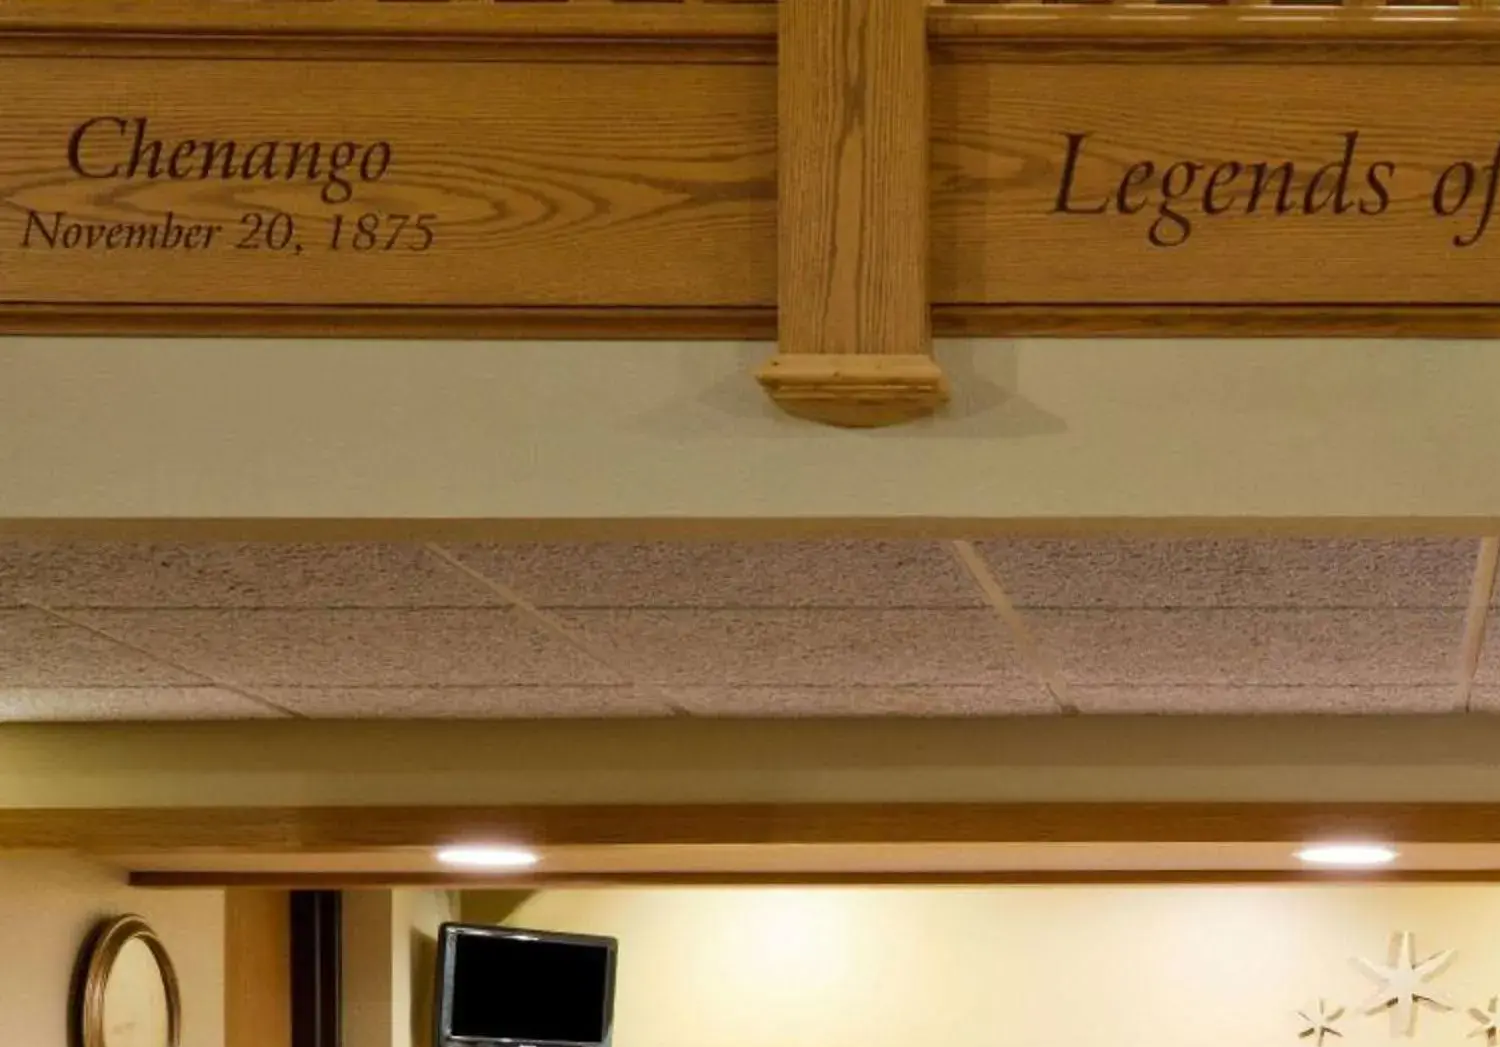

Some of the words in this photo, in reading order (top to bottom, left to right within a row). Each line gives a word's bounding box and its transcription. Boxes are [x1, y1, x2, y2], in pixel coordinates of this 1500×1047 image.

[66, 115, 392, 204] Chenango
[1051, 131, 1396, 248] Legends
[20, 210, 223, 251] November
[235, 213, 304, 256] 20,
[327, 212, 436, 253] 1875
